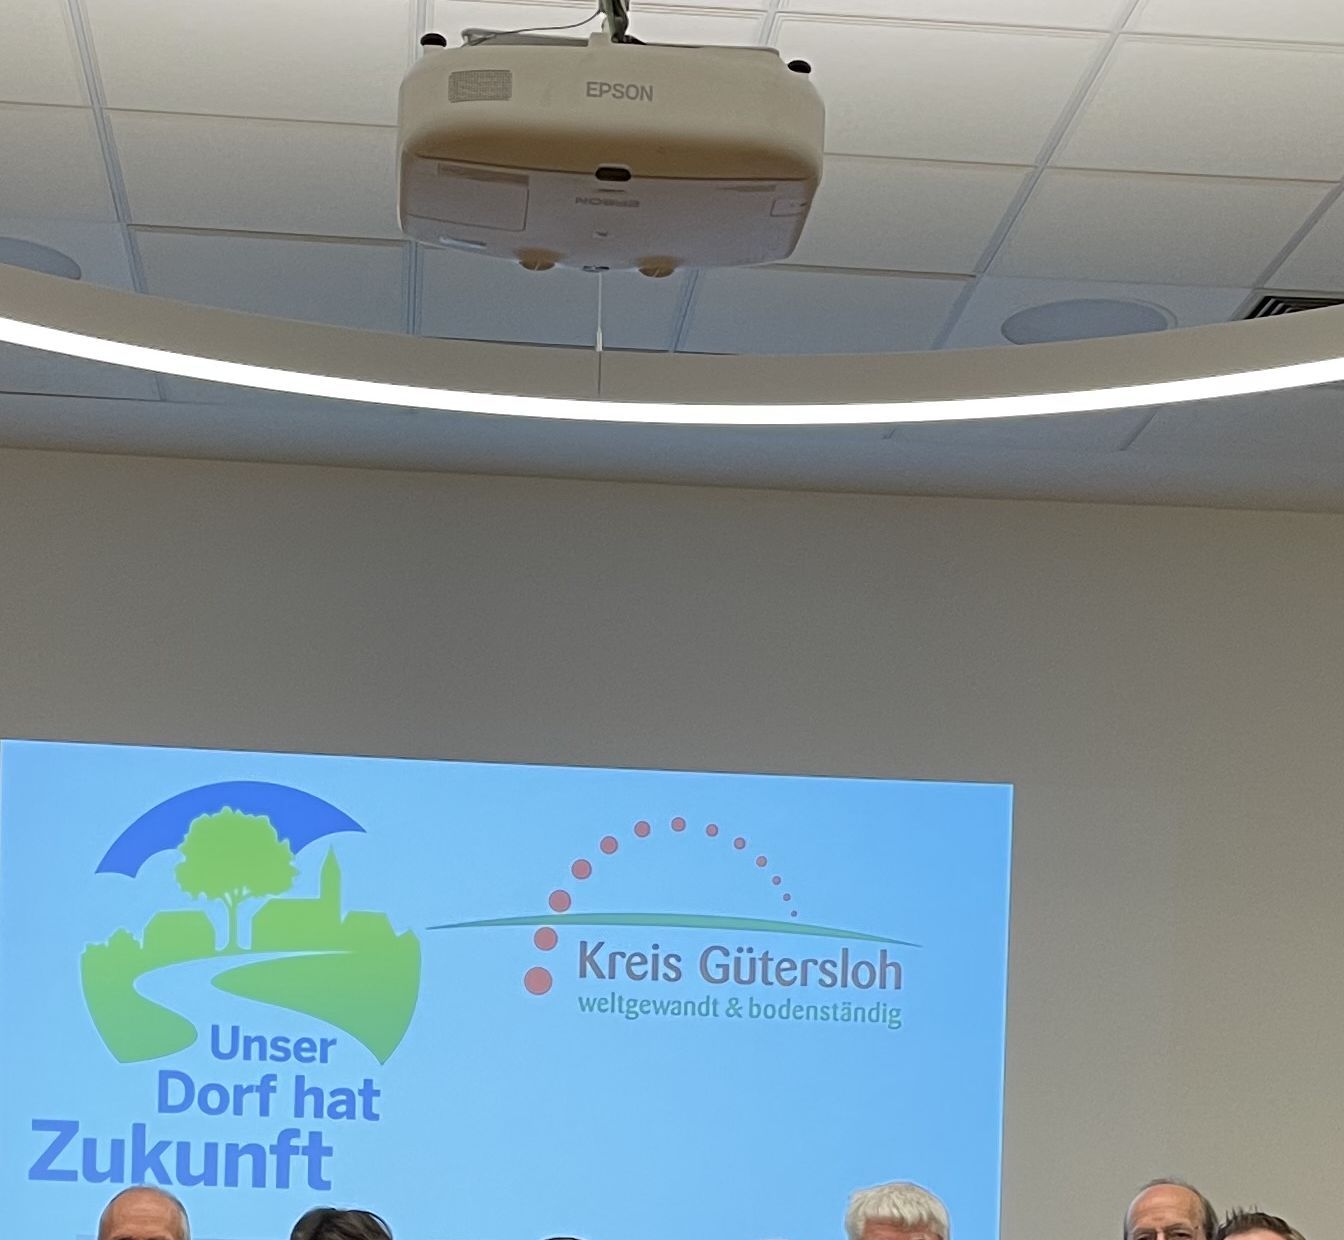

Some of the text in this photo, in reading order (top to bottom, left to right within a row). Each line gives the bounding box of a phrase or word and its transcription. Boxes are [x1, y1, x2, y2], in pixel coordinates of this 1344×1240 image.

[586, 81, 653, 101] EPSON
[578, 940, 902, 990] Kreis Gütersloh
[578, 991, 902, 1030] weltgewandt & bodenständig
[210, 1024, 337, 1063] Unser
[157, 1069, 381, 1122] Dorf hat
[28, 1118, 334, 1191] Zukunft
